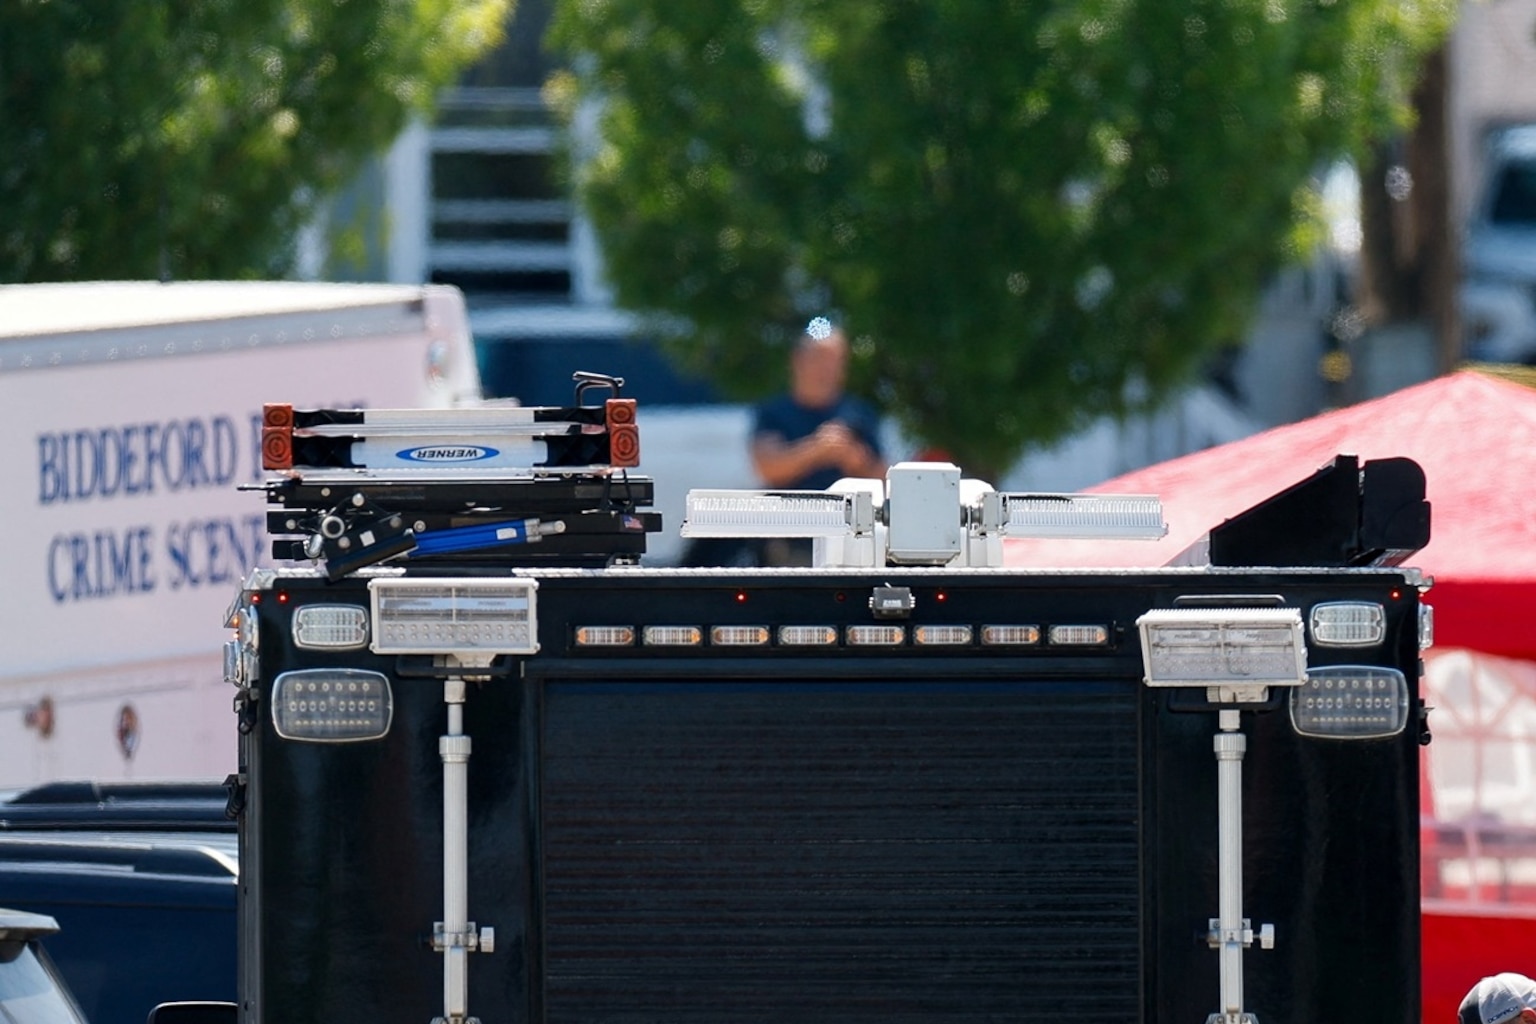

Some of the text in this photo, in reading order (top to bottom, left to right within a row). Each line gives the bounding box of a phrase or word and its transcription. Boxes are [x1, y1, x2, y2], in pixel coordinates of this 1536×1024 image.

[37, 415, 237, 506] BIDDEFORD
[416, 448, 478, 459] WERNER
[48, 525, 155, 602] CRIME
